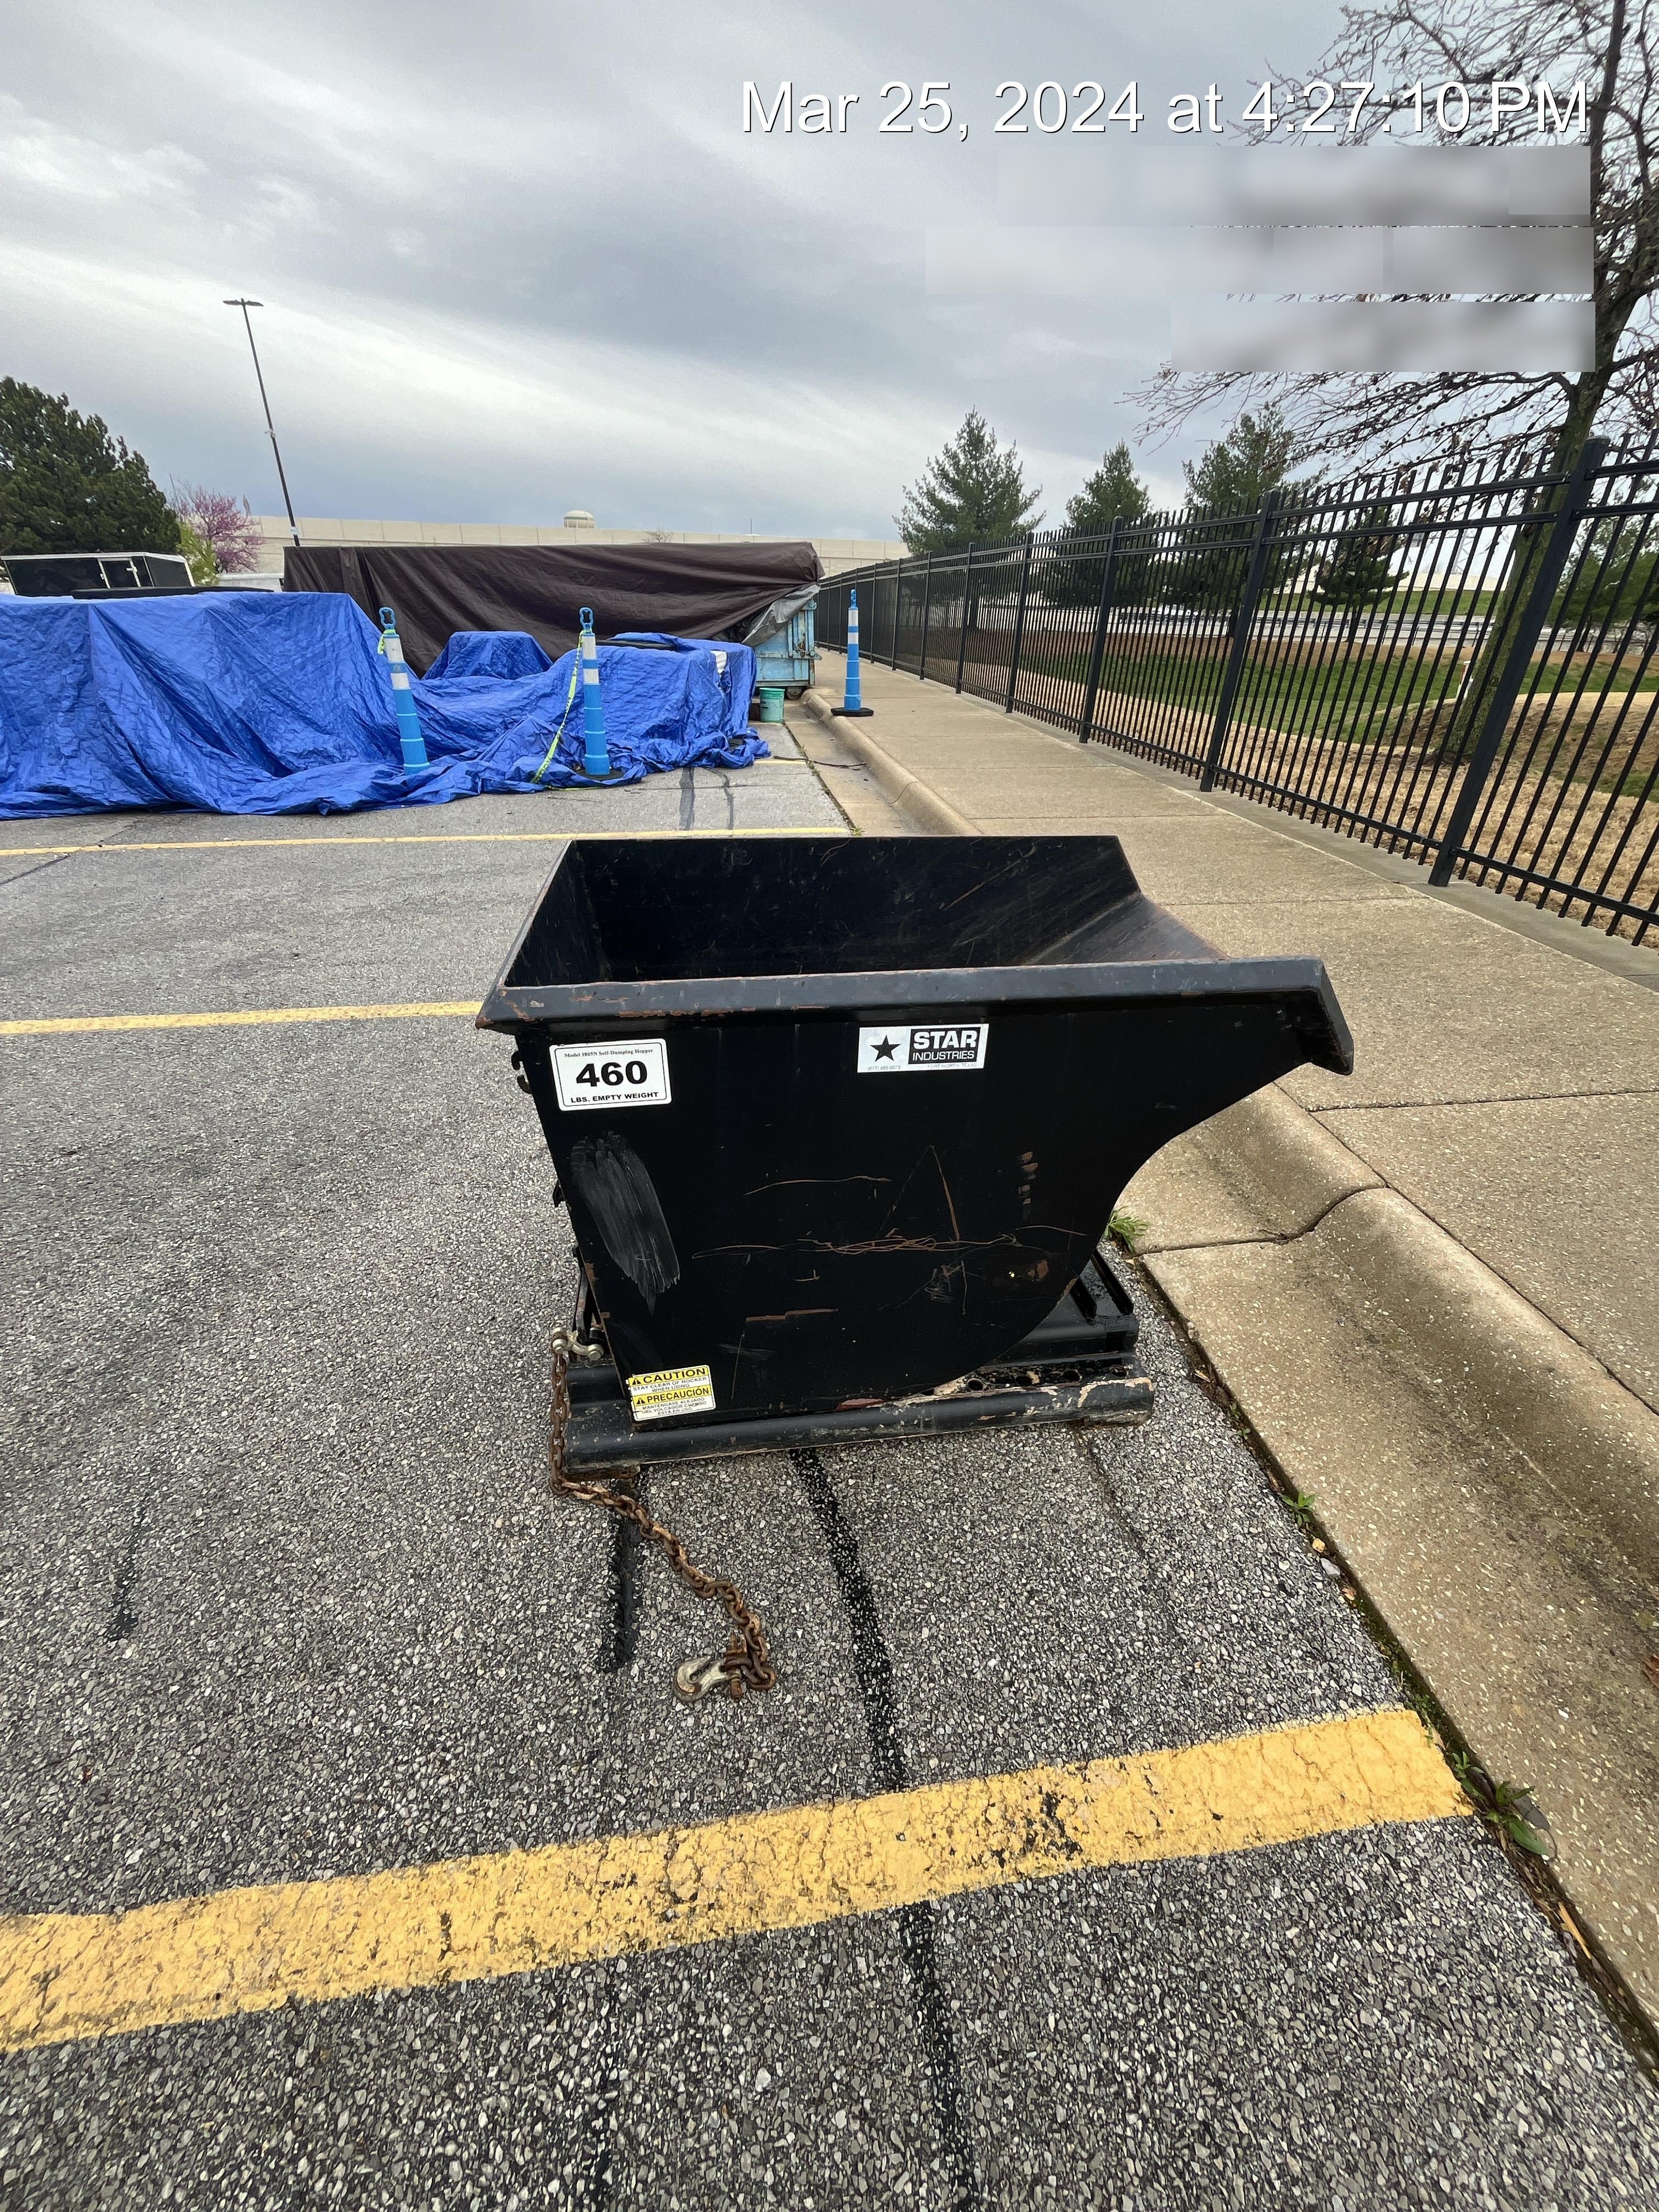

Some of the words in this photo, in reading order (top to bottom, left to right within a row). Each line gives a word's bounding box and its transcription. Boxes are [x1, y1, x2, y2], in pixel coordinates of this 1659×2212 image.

[913, 1030, 978, 1050] STAR
[912, 1050, 975, 1062] INDUSTRIES
[576, 1060, 647, 1087] 460
[643, 1368, 705, 1383] CAUTION
[647, 1386, 709, 1403] PRECAUCIÓN
